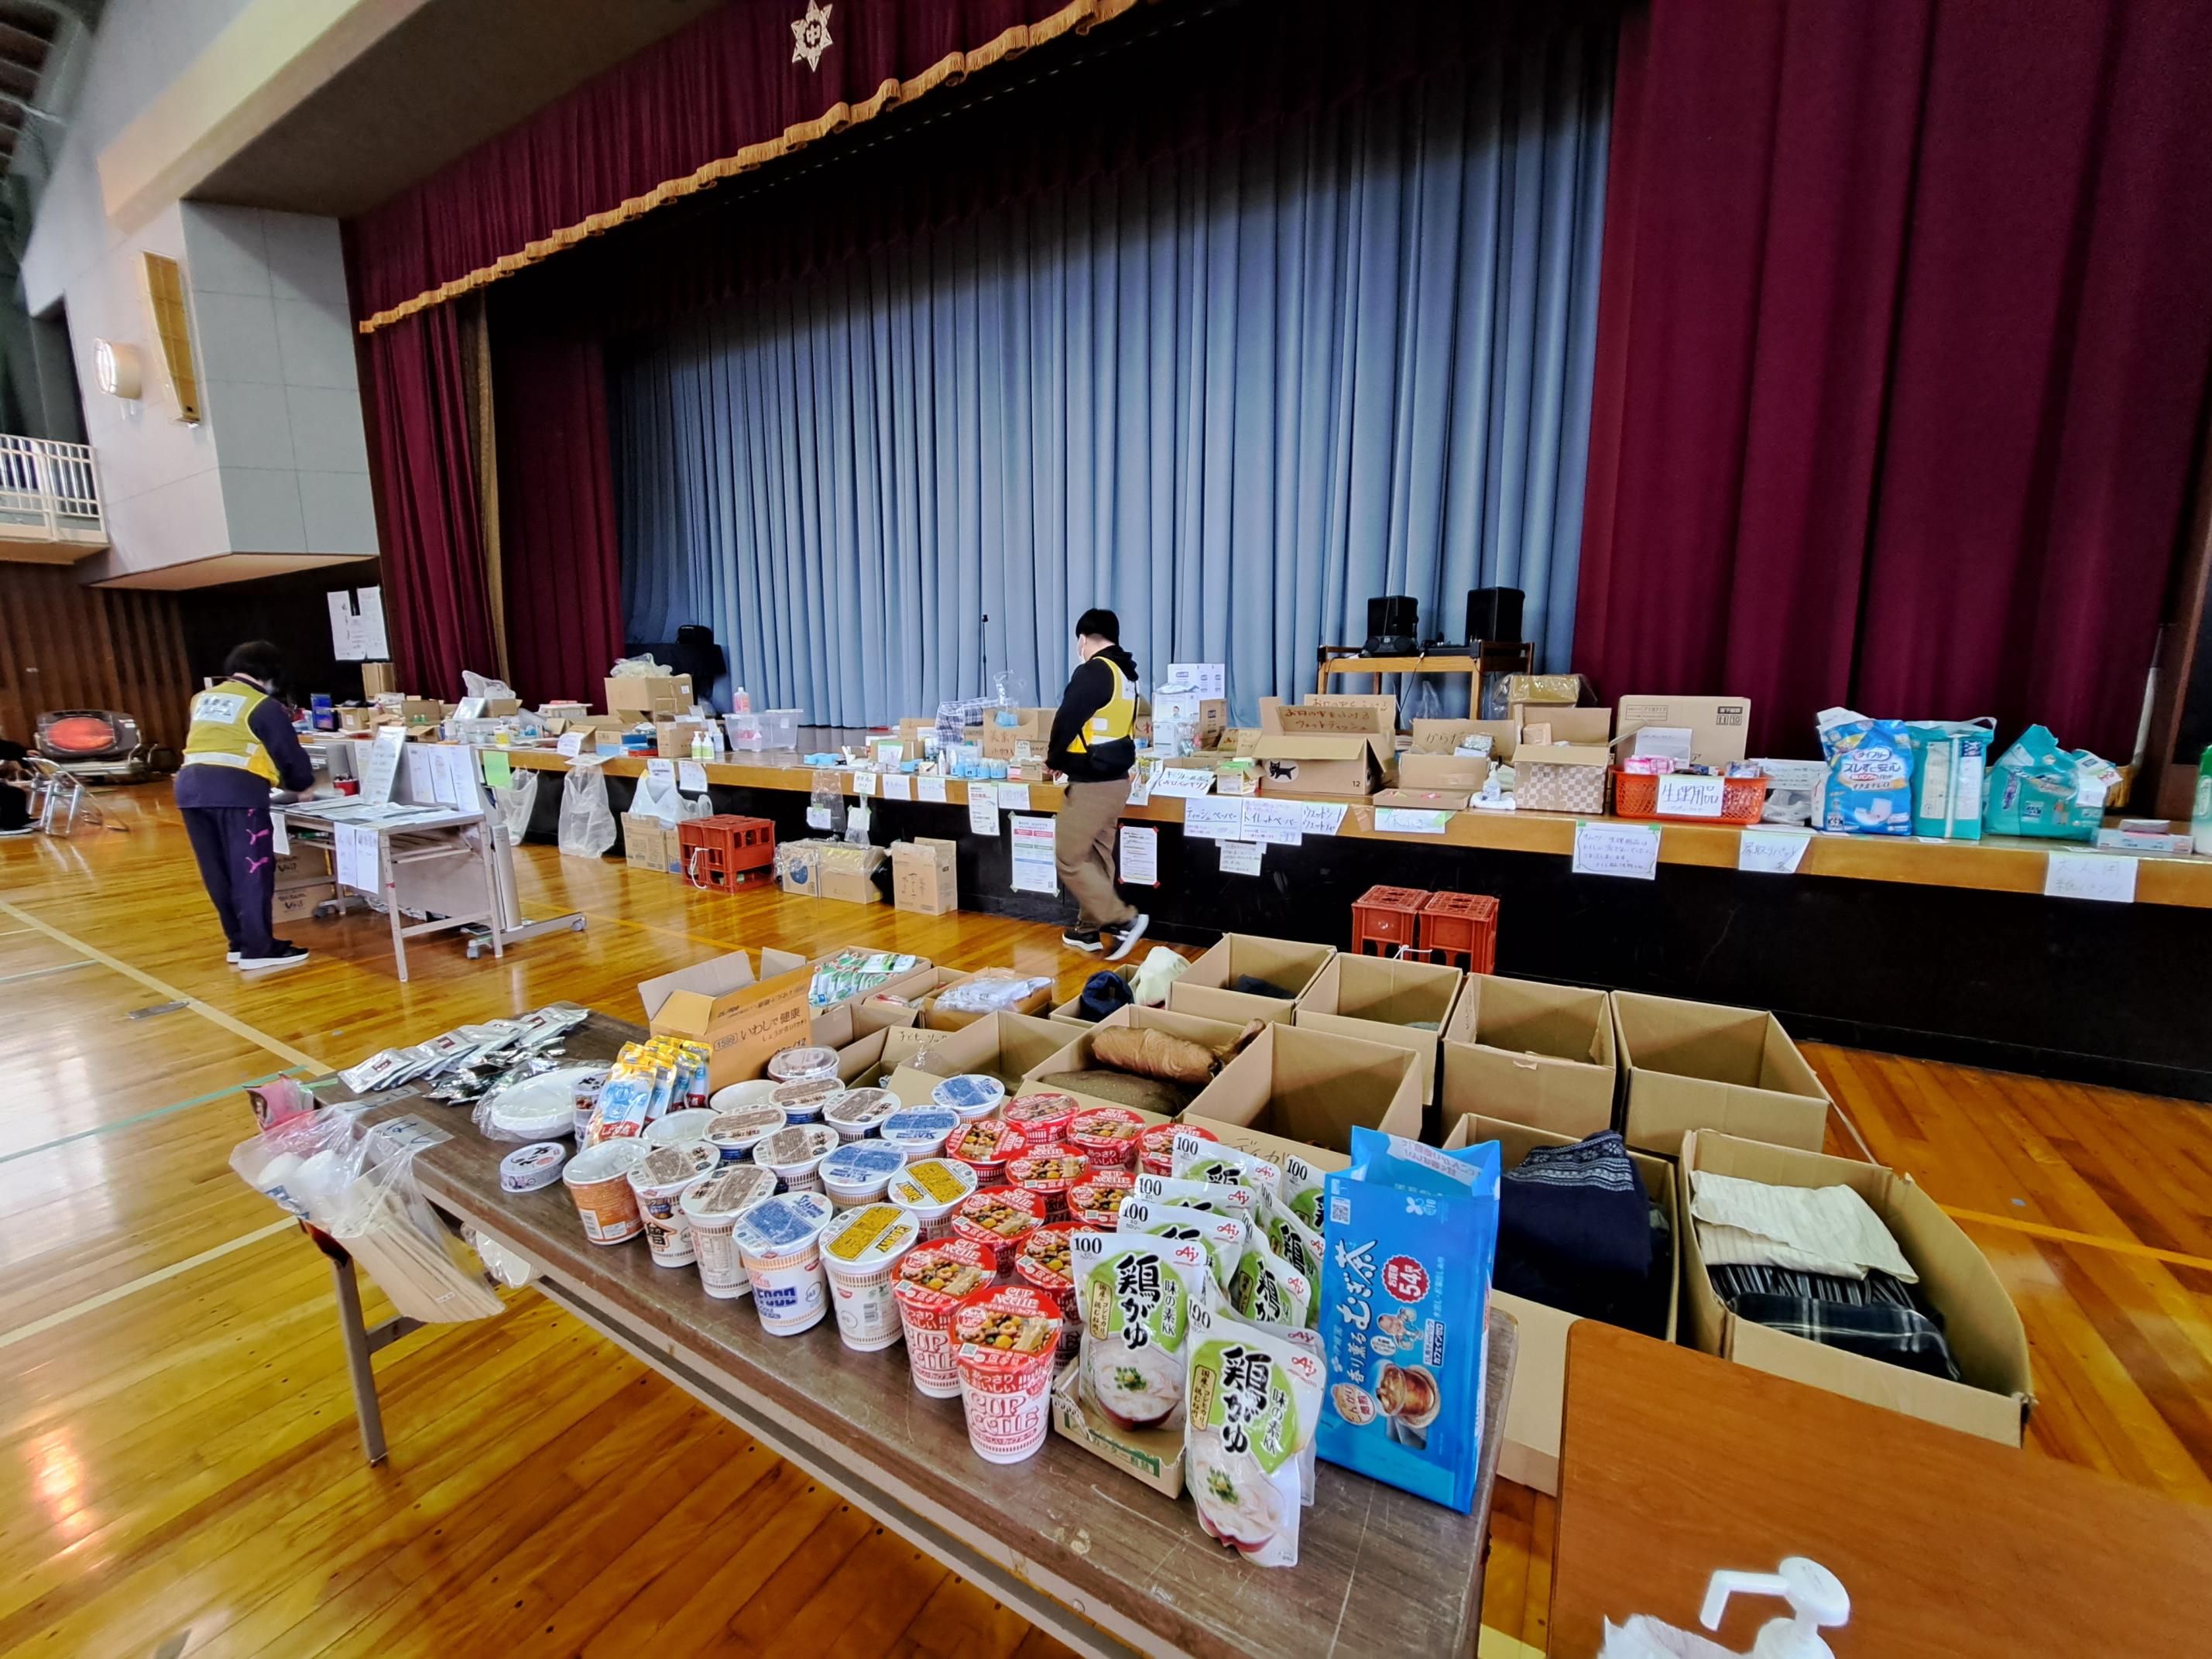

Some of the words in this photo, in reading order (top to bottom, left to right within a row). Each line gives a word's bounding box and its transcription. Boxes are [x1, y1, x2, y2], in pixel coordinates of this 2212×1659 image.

[1662, 783, 1720, 805] 生理用品
[740, 1007, 801, 1040] いわしで健康
[717, 1036, 736, 1049] 1599
[1177, 1136, 1199, 1157] 100
[1286, 1159, 1308, 1181] 100
[1138, 1177, 1162, 1197] 100
[1123, 1203, 1149, 1223] 100
[941, 1243, 982, 1260] NOODLE
[1075, 1237, 1103, 1255] 100
[1005, 1286, 1035, 1299] CUP
[1335, 1239, 1378, 1331] むぎ茶
[993, 1293, 1040, 1309] NOODLE
[1115, 1254, 1161, 1350] 鶏がゆ
[1188, 1299, 1212, 1329] 100
[1346, 1332, 1368, 1384] 香り薫る
[971, 1380, 1017, 1393] おいしい
[972, 1371, 1014, 1385] あっさり
[970, 1391, 1027, 1417] CUP
[1223, 1346, 1272, 1453] 鶏がゆ
